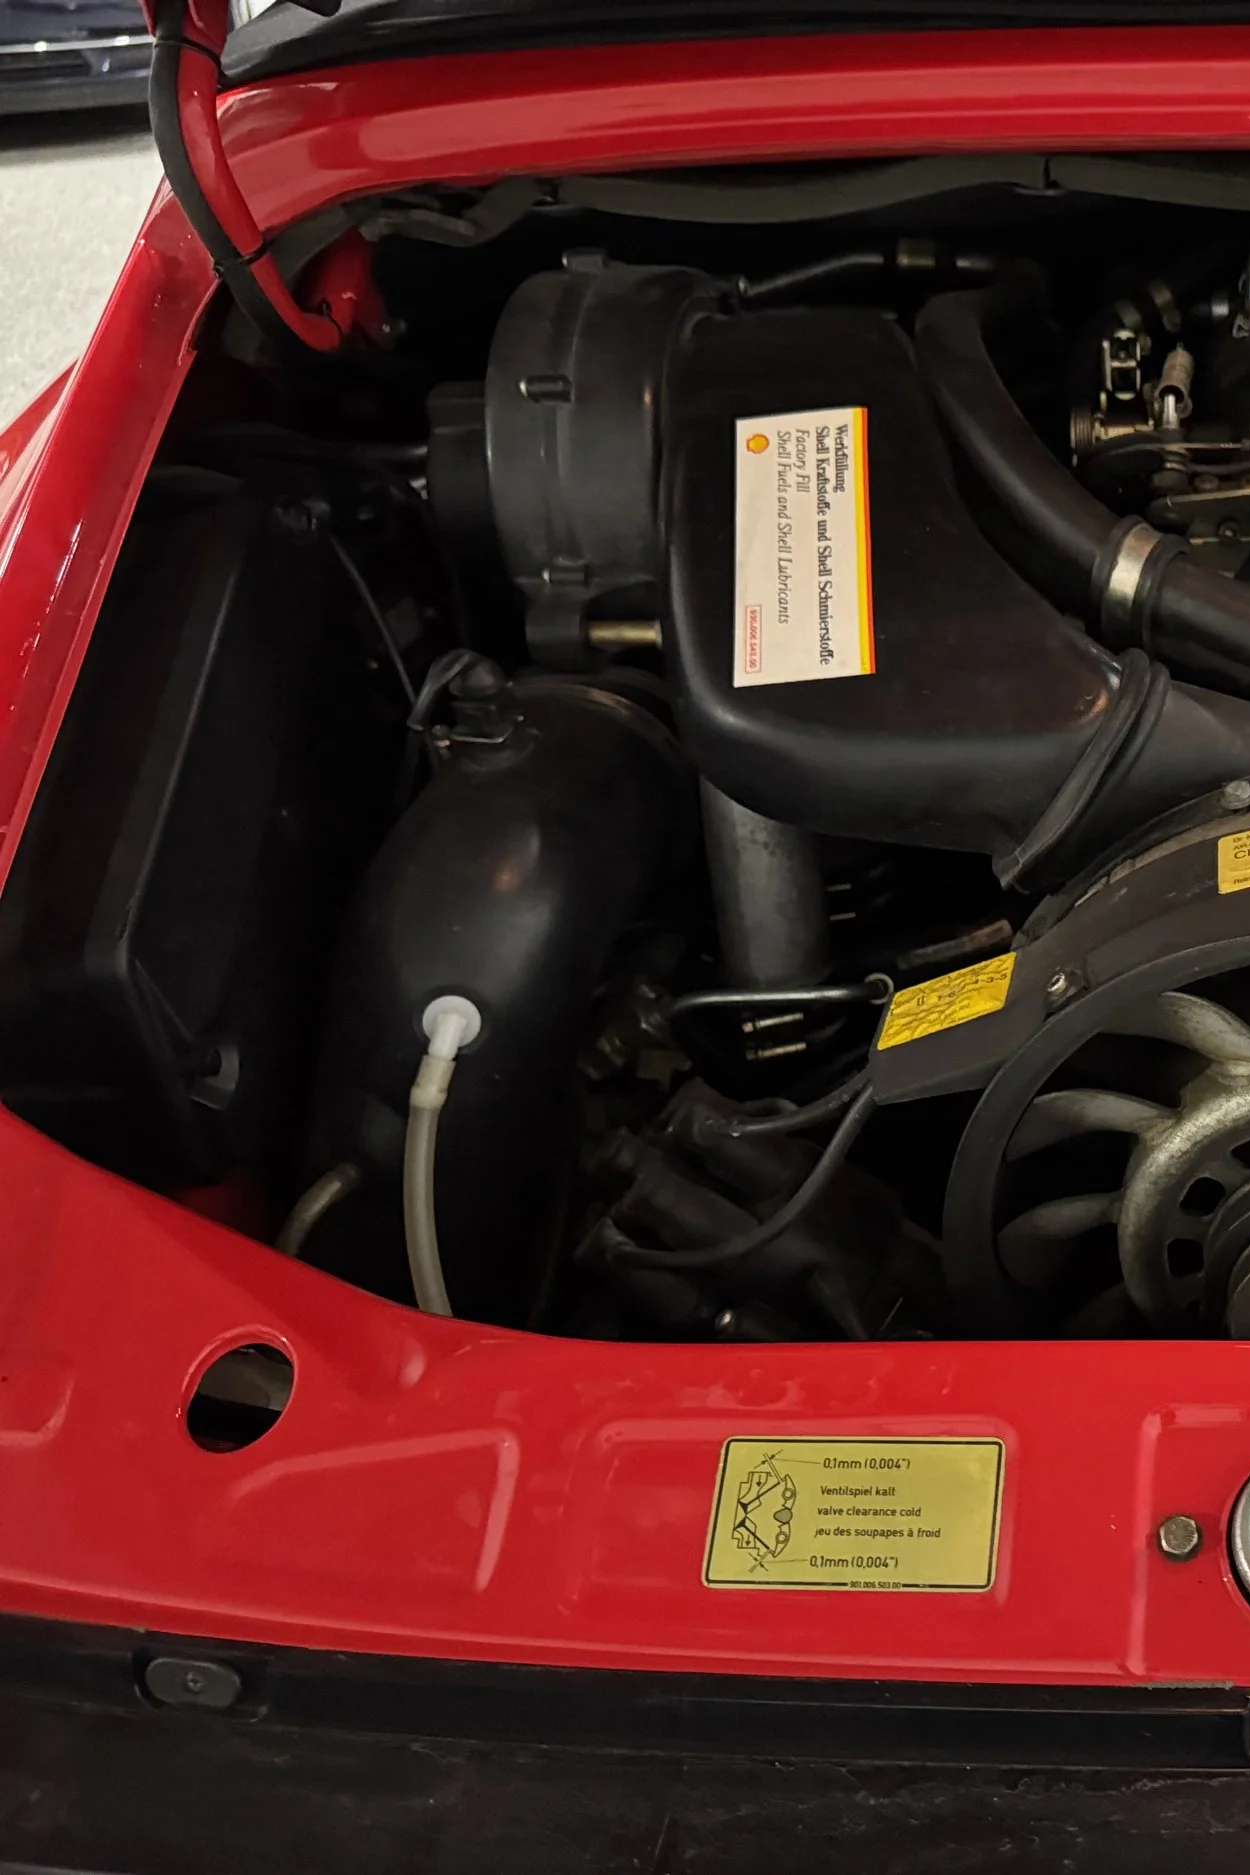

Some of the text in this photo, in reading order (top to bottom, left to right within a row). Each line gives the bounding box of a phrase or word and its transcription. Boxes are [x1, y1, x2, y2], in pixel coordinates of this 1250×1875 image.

[793, 429, 810, 493] Factory Fill
[833, 424, 848, 493] Werkfüllung
[777, 430, 793, 624] Shell Fuels and Shell Lubricants
[816, 426, 834, 665] Shell Kraftstoffe und Shell Schmierstoffe
[823, 1457, 862, 1470] 0,1mm
[820, 1486, 896, 1498] Ventilspiel kalt
[817, 1506, 921, 1517] valve clearance cold
[814, 1527, 831, 1538] jeu
[833, 1526, 852, 1537] des
[854, 1528, 905, 1539] soupapes
[917, 1527, 941, 1538] froid
[809, 1555, 849, 1568] 0,1mm
